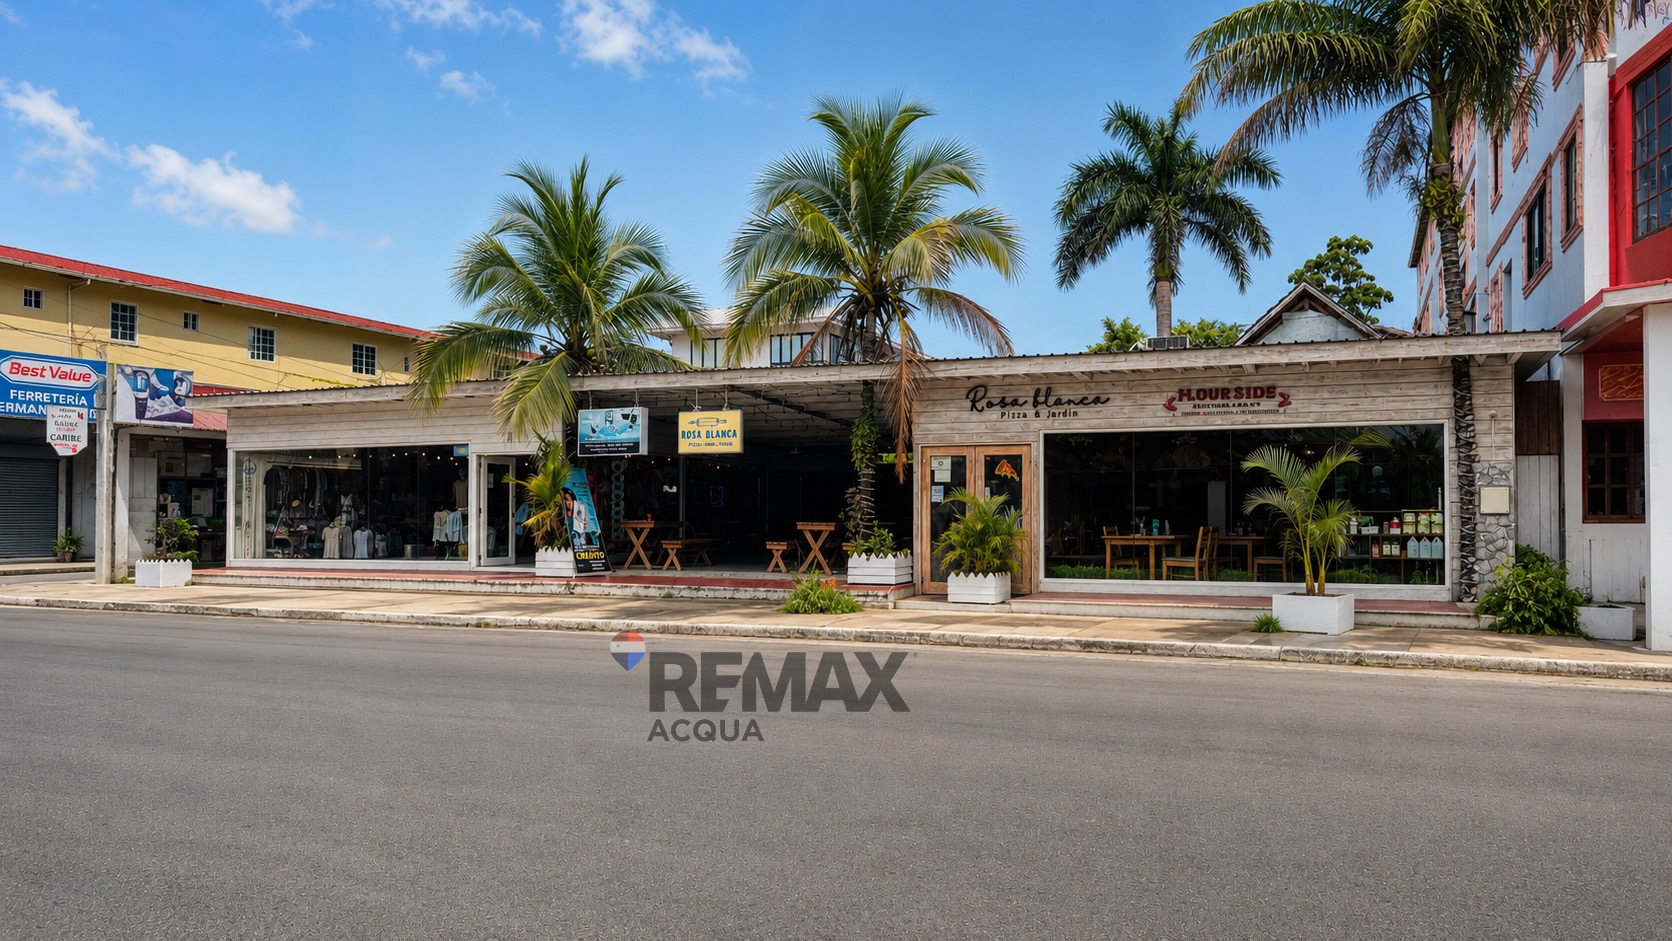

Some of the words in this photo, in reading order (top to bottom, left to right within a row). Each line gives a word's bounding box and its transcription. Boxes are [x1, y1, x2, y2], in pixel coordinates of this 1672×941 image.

[9, 361, 47, 378] Best
[49, 365, 92, 382] Value
[10, 389, 88, 406] FERRETERÍA
[965, 385, 1028, 413] Rosa
[0, 402, 47, 415] ERMAN
[1000, 410, 1028, 419] Pizza
[681, 430, 702, 439] ROSA
[705, 429, 738, 439] BLANCA
